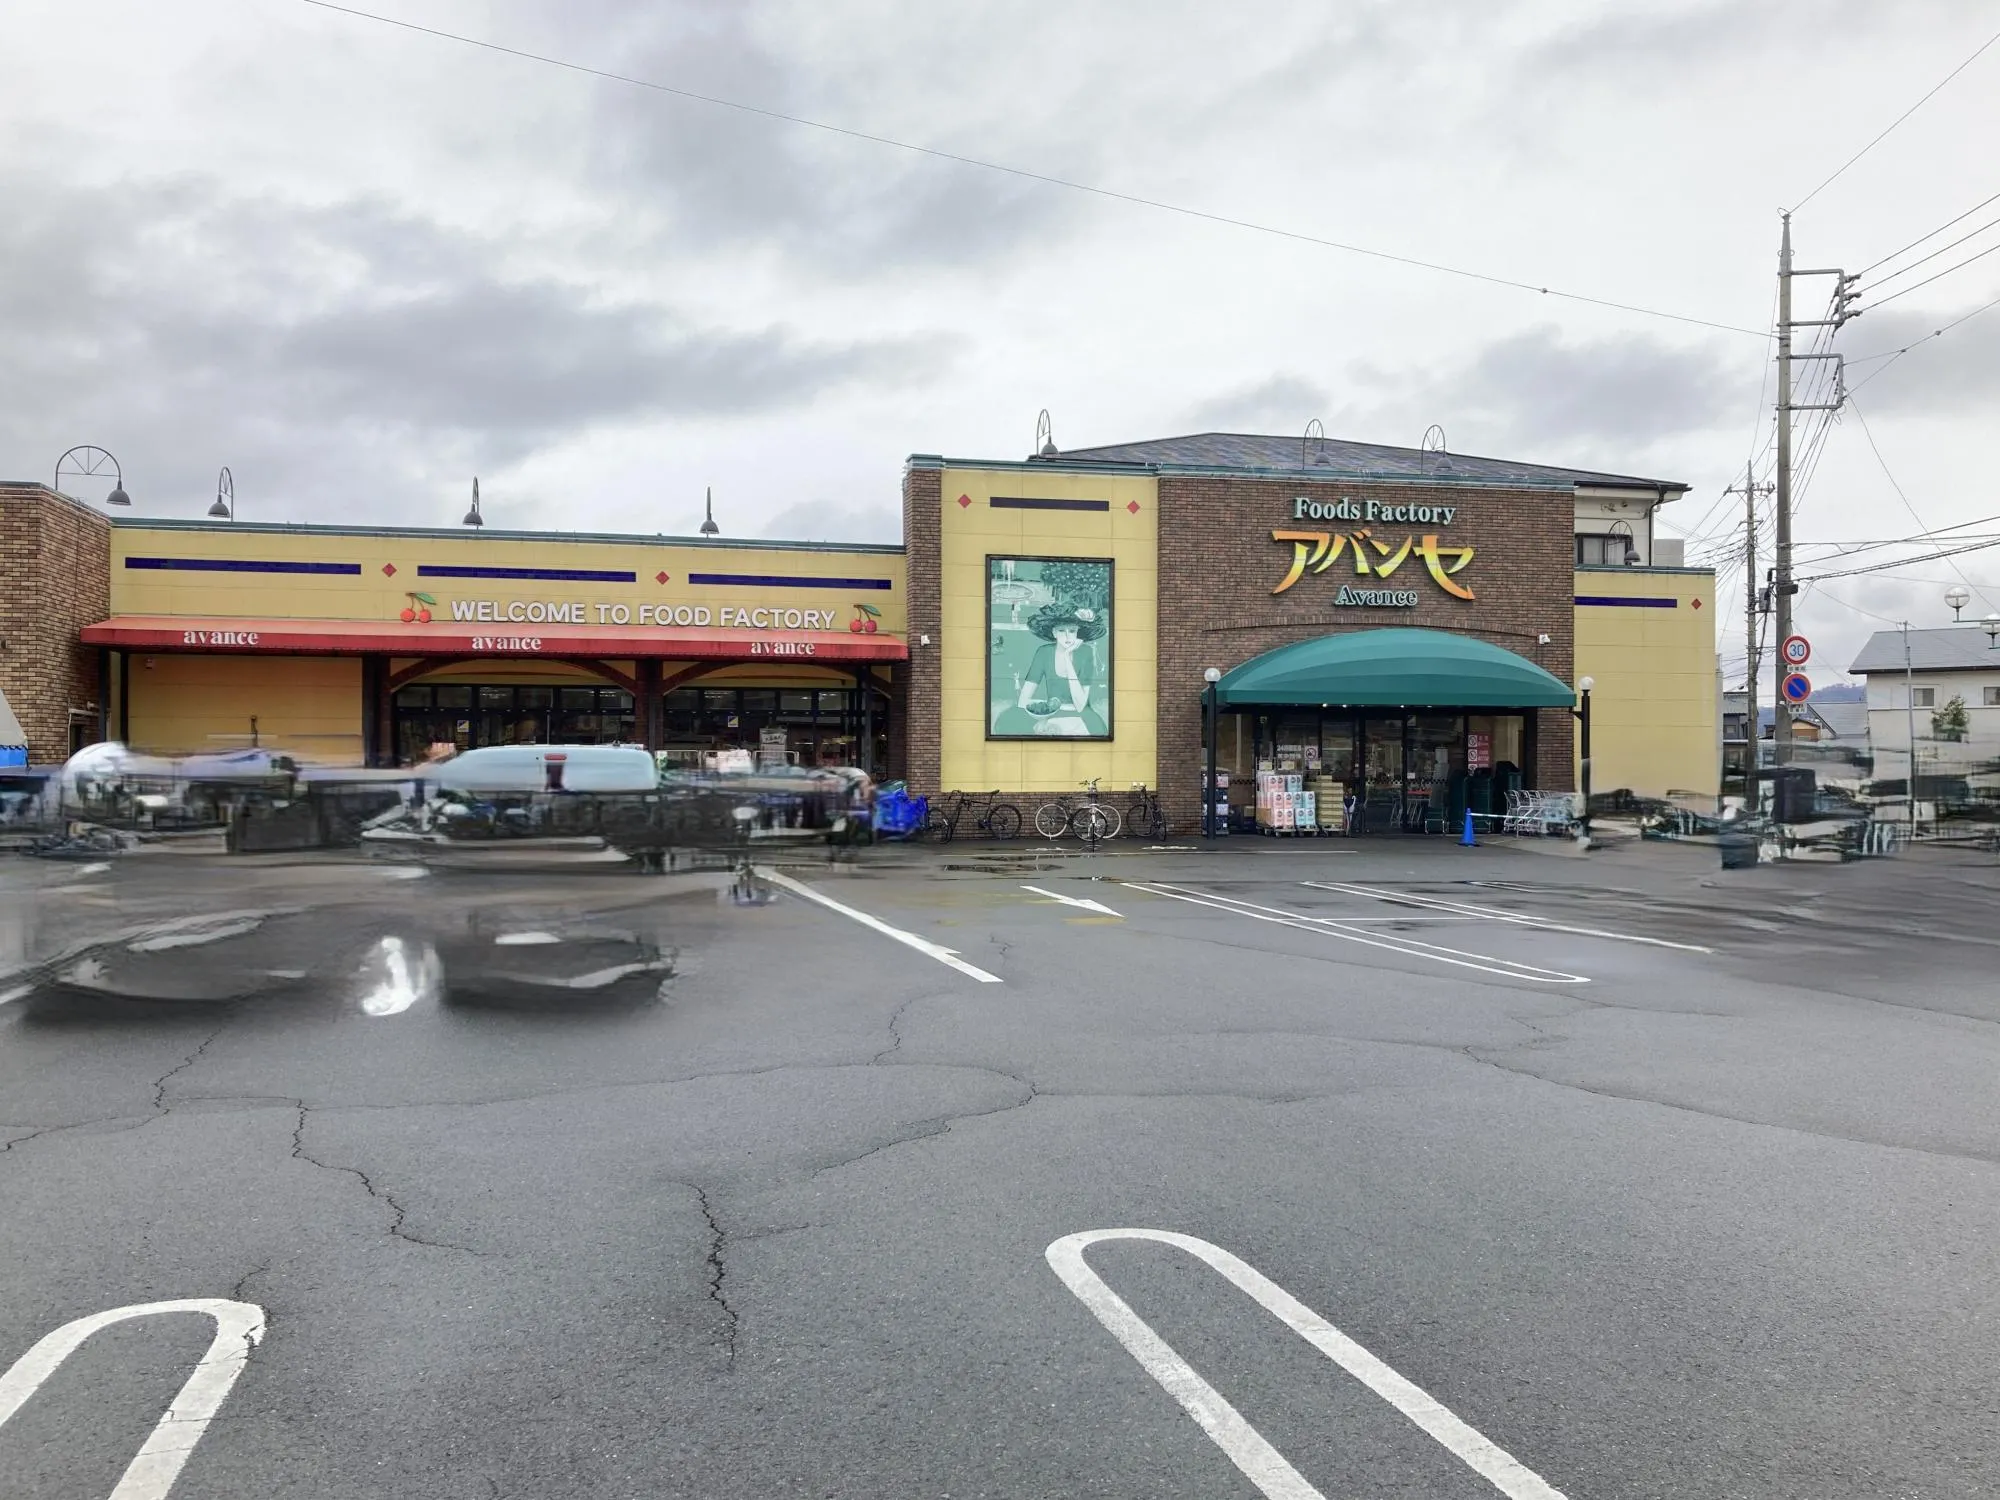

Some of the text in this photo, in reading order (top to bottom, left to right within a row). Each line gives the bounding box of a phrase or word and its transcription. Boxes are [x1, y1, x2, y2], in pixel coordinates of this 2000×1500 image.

[1294, 497, 1457, 525] Foods Factory
[1272, 529, 1476, 601] アバンセ
[1335, 585, 1418, 606] Avance
[451, 600, 836, 630] WELCOME TO FOOD FACTORY
[183, 631, 259, 645] avance
[472, 636, 541, 650] avance
[750, 641, 815, 655] avance
[1789, 644, 1805, 657] 30
